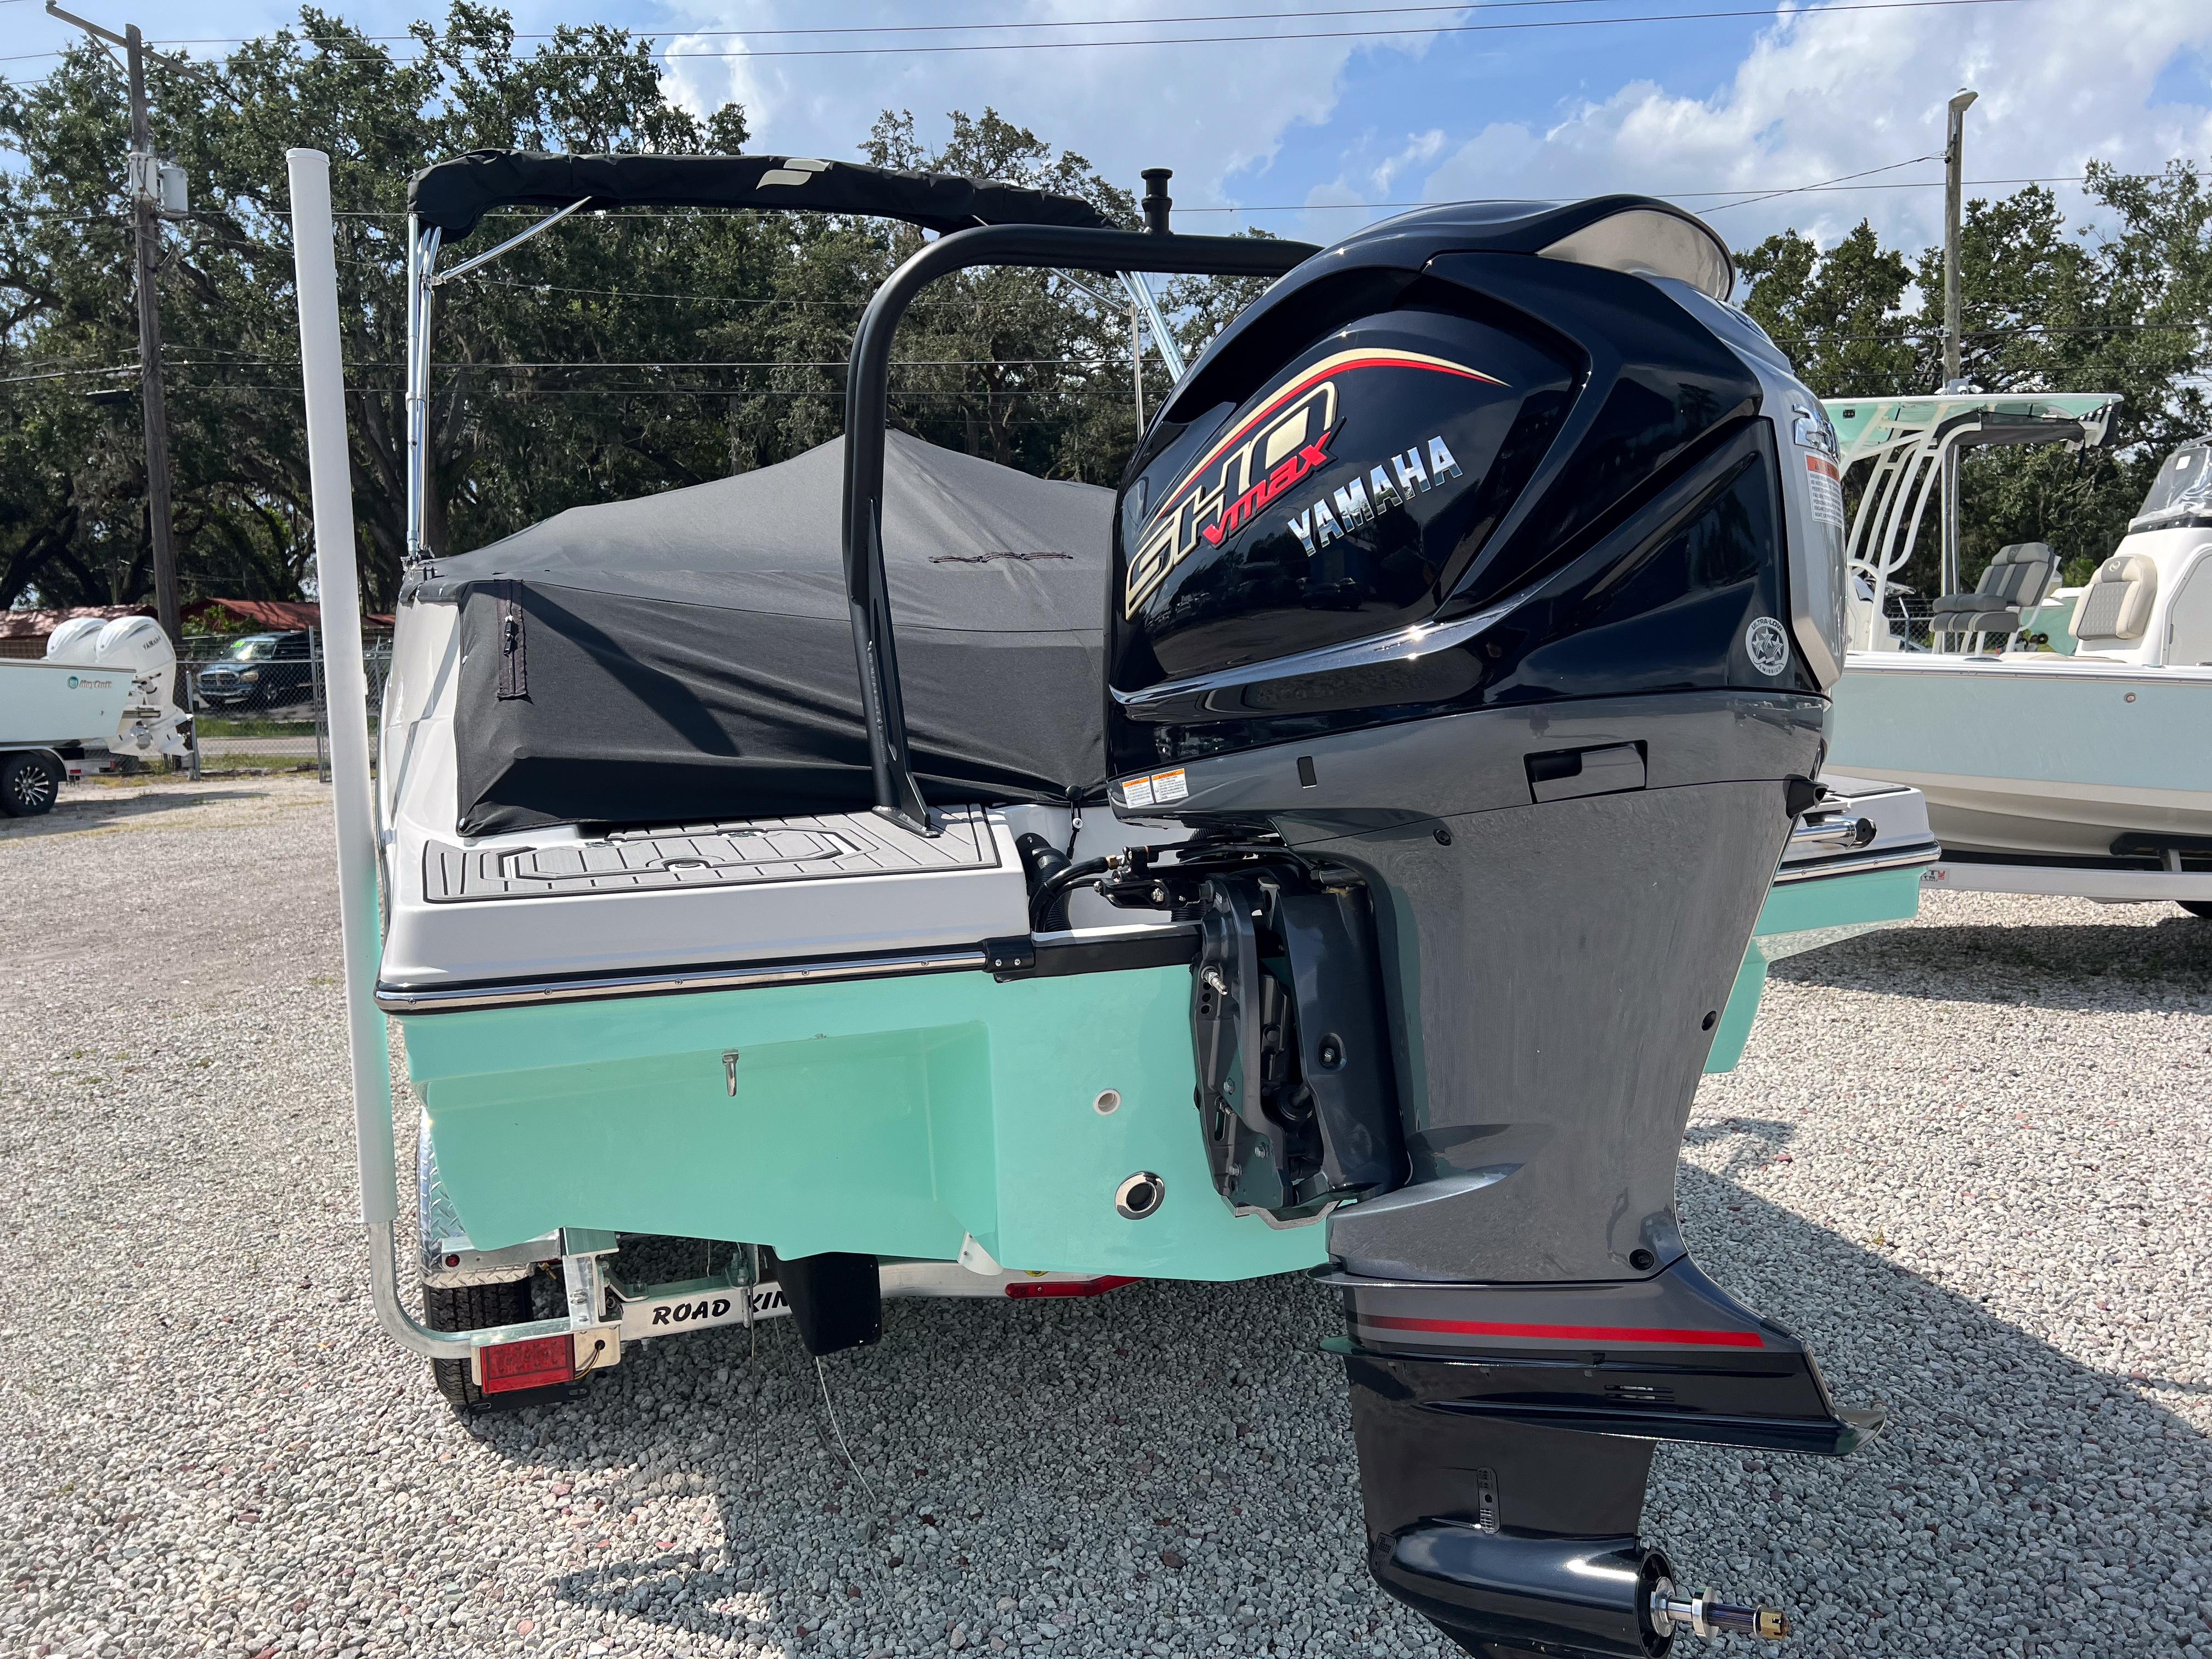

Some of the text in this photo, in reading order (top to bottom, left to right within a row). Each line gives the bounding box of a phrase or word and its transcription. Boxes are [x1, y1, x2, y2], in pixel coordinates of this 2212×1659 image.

[1126, 381, 1339, 620] SHO
[1287, 435, 1463, 557] YAMAHA
[652, 1290, 789, 1325] ROAD KIN
